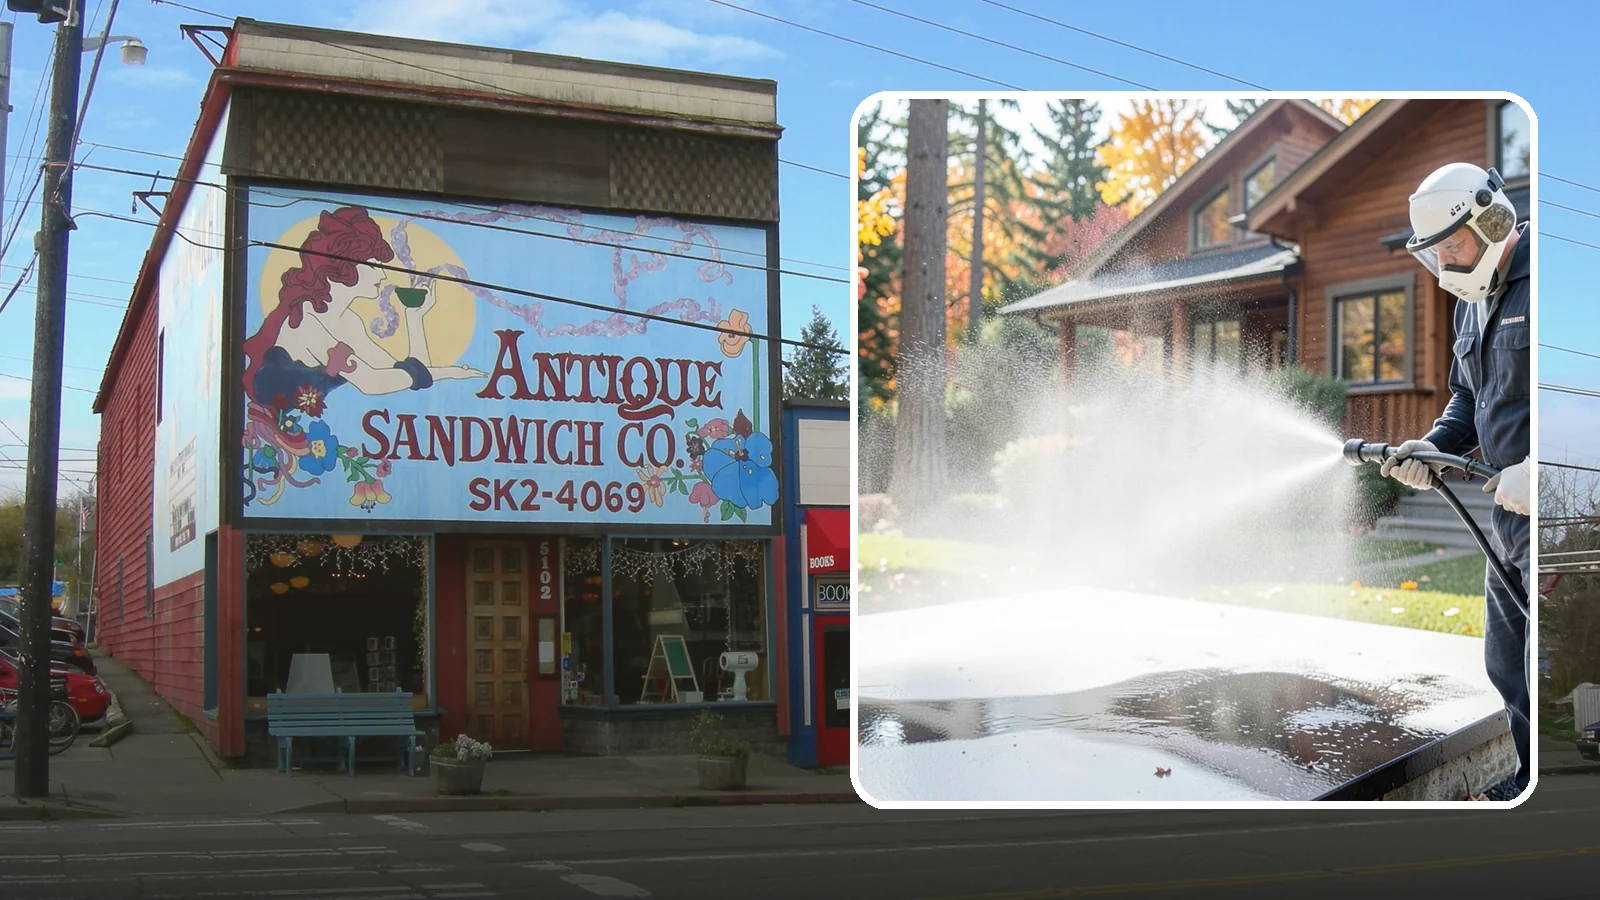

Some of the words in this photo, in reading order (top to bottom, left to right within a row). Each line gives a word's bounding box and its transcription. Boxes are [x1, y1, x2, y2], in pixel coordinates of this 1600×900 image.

[475, 329, 723, 421] ANTIQUE
[361, 409, 605, 467] SANDWICH
[617, 422, 685, 467] CO.
[469, 478, 645, 514] SK2-4069
[539, 541, 551, 600] 5102
[809, 555, 834, 568] BOOKS
